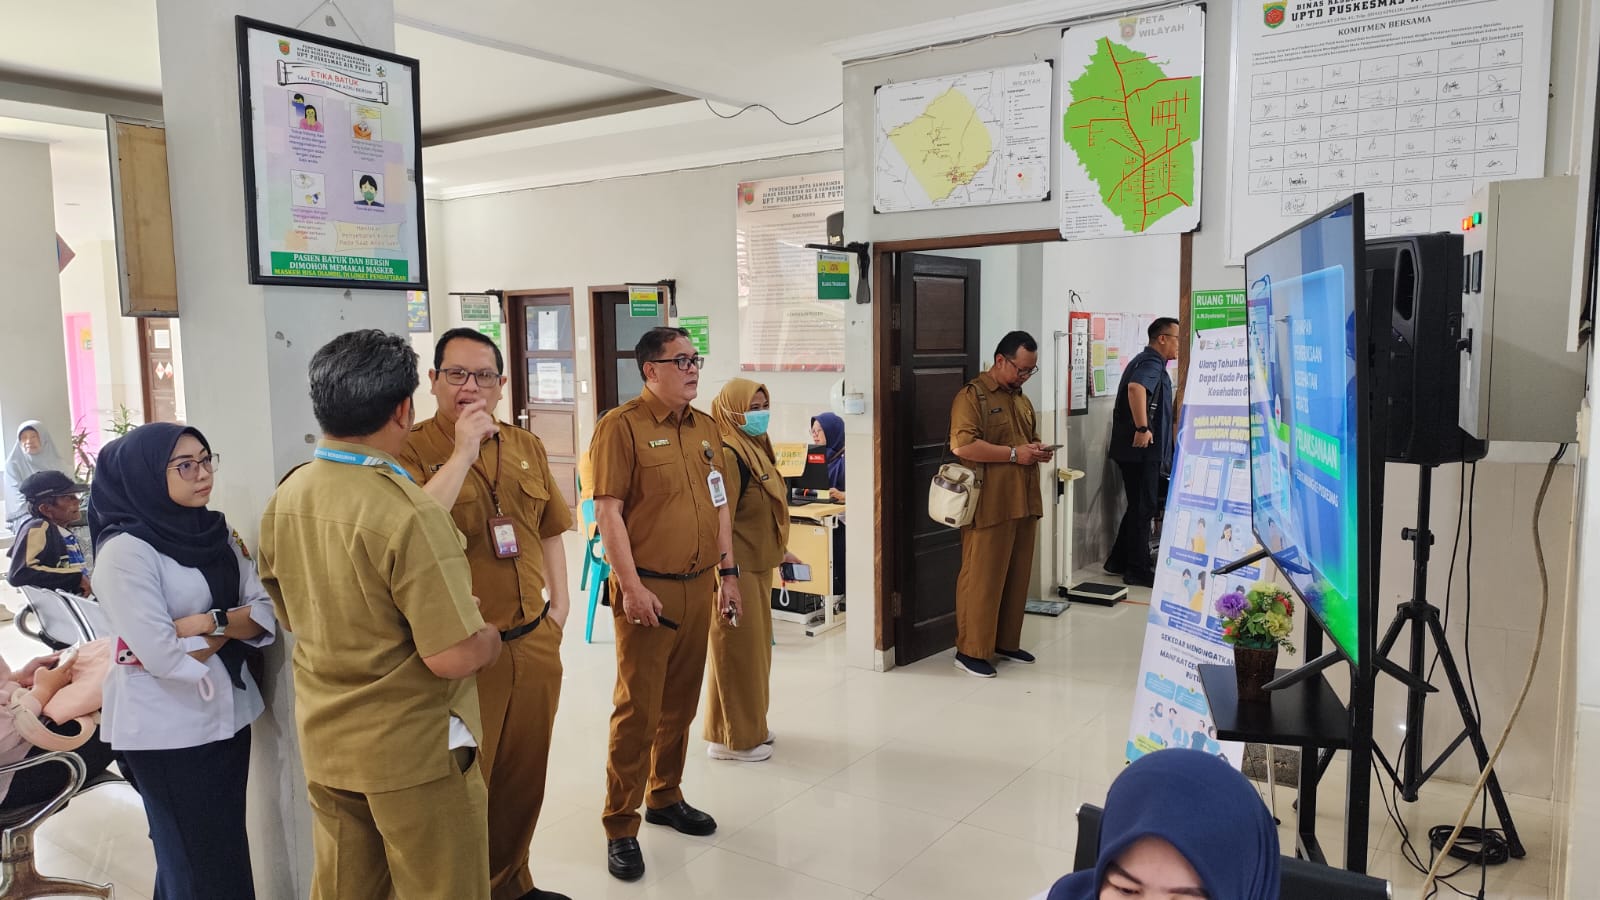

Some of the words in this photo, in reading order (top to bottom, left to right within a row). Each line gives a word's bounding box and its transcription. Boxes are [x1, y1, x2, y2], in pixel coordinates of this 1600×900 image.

[1296, 0, 1324, 11] DINAS
[1139, 15, 1165, 25] PETA
[1291, 7, 1323, 22] UPTD
[1139, 23, 1185, 37] WILAYAH
[1338, 21, 1387, 36] KOMITMEN
[1389, 15, 1432, 28] BERSAMA
[310, 53, 342, 66] PUSKESMAS
[355, 64, 371, 72] PUTIH
[311, 70, 334, 81] ETIKA
[334, 76, 358, 86] BATUK
[776, 194, 812, 204] PUSKESMAS
[294, 253, 320, 262] PASIEN
[322, 254, 348, 264] BATUK
[349, 256, 364, 265] DAN
[365, 257, 390, 266] BERSIN
[290, 261, 328, 271] DIMOHON
[329, 263, 364, 273] MEMAKAI
[366, 265, 394, 274] MASKER
[1196, 294, 1223, 306] RUANG
[1294, 345, 1323, 364] PEMERIKSAAN
[1198, 360, 1217, 371] Ulang
[1218, 358, 1238, 369] Tahun
[1199, 373, 1218, 386] Dapat
[1219, 372, 1235, 382] Kado
[1294, 370, 1318, 392] KESEHATAN
[1208, 387, 1242, 396] Kesehatan
[1296, 426, 1337, 470] PELAKSANAAN
[1161, 633, 1186, 647] SEKEDAR
[1160, 650, 1188, 666] MANFAAT
